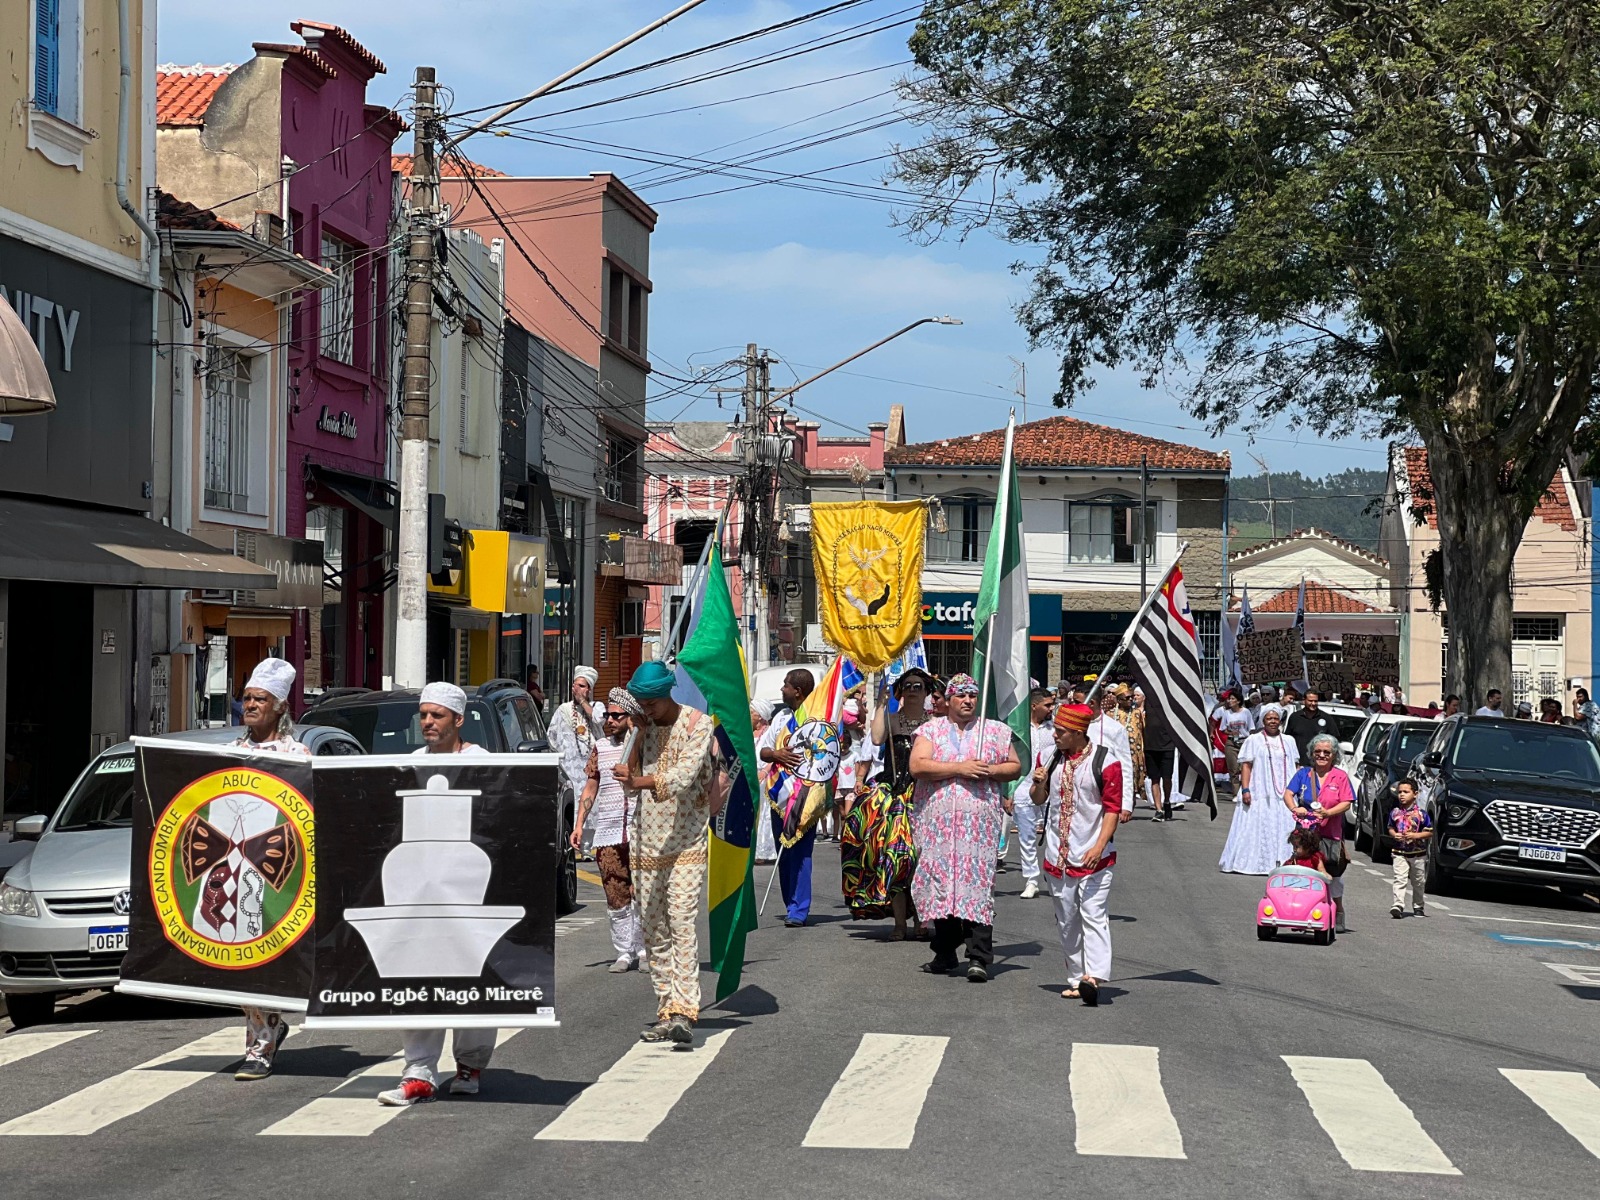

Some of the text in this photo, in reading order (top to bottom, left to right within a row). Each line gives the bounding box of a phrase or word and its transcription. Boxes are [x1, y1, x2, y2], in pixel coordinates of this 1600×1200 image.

[1246, 629, 1283, 640] ESTADO
[1276, 636, 1295, 645] MAS
[1342, 634, 1367, 642] ORAR
[1240, 653, 1292, 665] DIANTE DE
[1262, 668, 1304, 680] QUANDO?
[222, 774, 261, 788] ABUC
[154, 808, 183, 904] CANDOMBLE
[162, 904, 173, 916] E
[171, 915, 230, 960] UMBANDA
[236, 947, 253, 961] DE
[319, 987, 544, 1006] Grupo Egbé Nagô Mirerê
